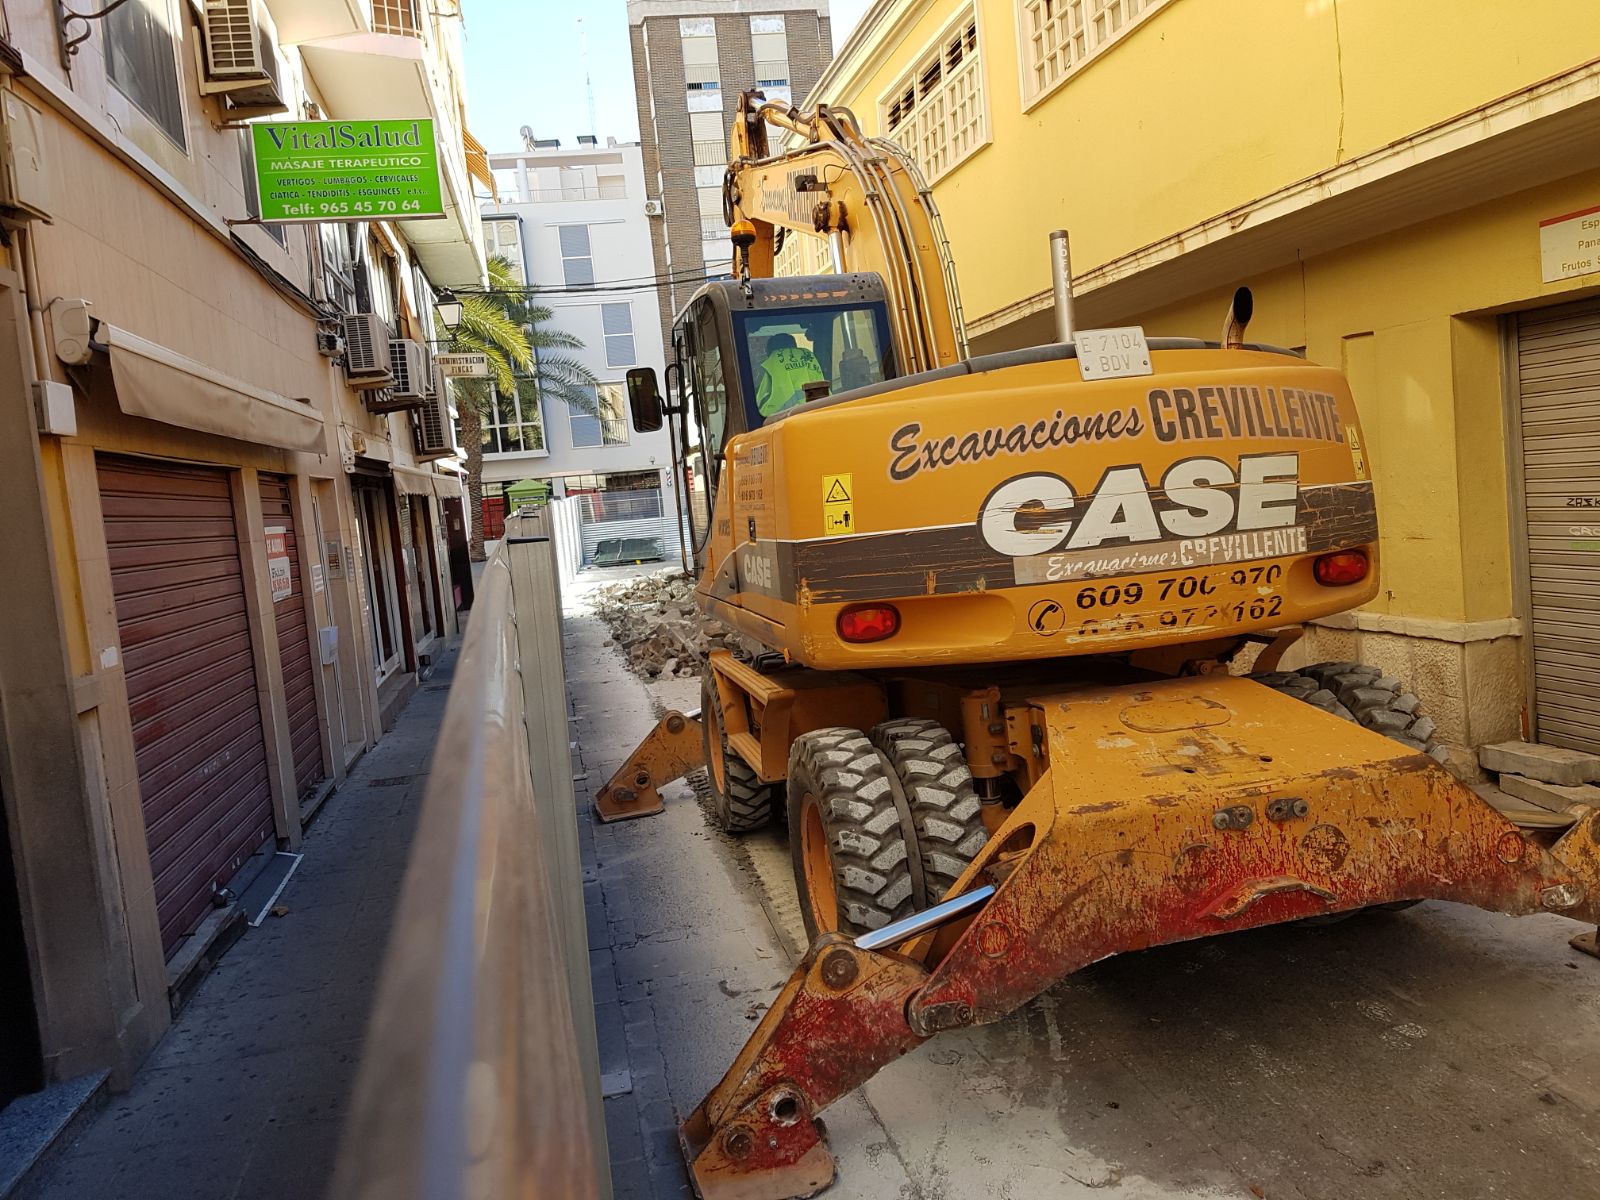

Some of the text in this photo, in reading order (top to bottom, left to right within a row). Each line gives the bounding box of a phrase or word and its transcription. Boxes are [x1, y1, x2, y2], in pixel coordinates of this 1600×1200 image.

[265, 122, 422, 150] VitalSalud
[271, 157, 422, 170] MASAJE TERAPEUTICO
[277, 175, 419, 187] VERTIGOS LUMBAGOS CERVICALES
[269, 190, 299, 199] CIATICA
[307, 189, 350, 198] TENDIDITIS
[358, 187, 400, 196] ESGUINCES
[282, 200, 421, 215] Telf: 965 45 70 64
[1561, 259, 1592, 273] Frutos
[1080, 333, 1141, 353] E 7104
[438, 356, 485, 365] ADMINISTRACION
[1100, 354, 1130, 372] BDV
[451, 365, 473, 374] FINCAS
[889, 387, 1344, 480] Excavaciones CREVILLENTE
[979, 453, 1299, 557] CASE
[743, 554, 771, 588] CASE
[1076, 582, 1143, 609] 609
